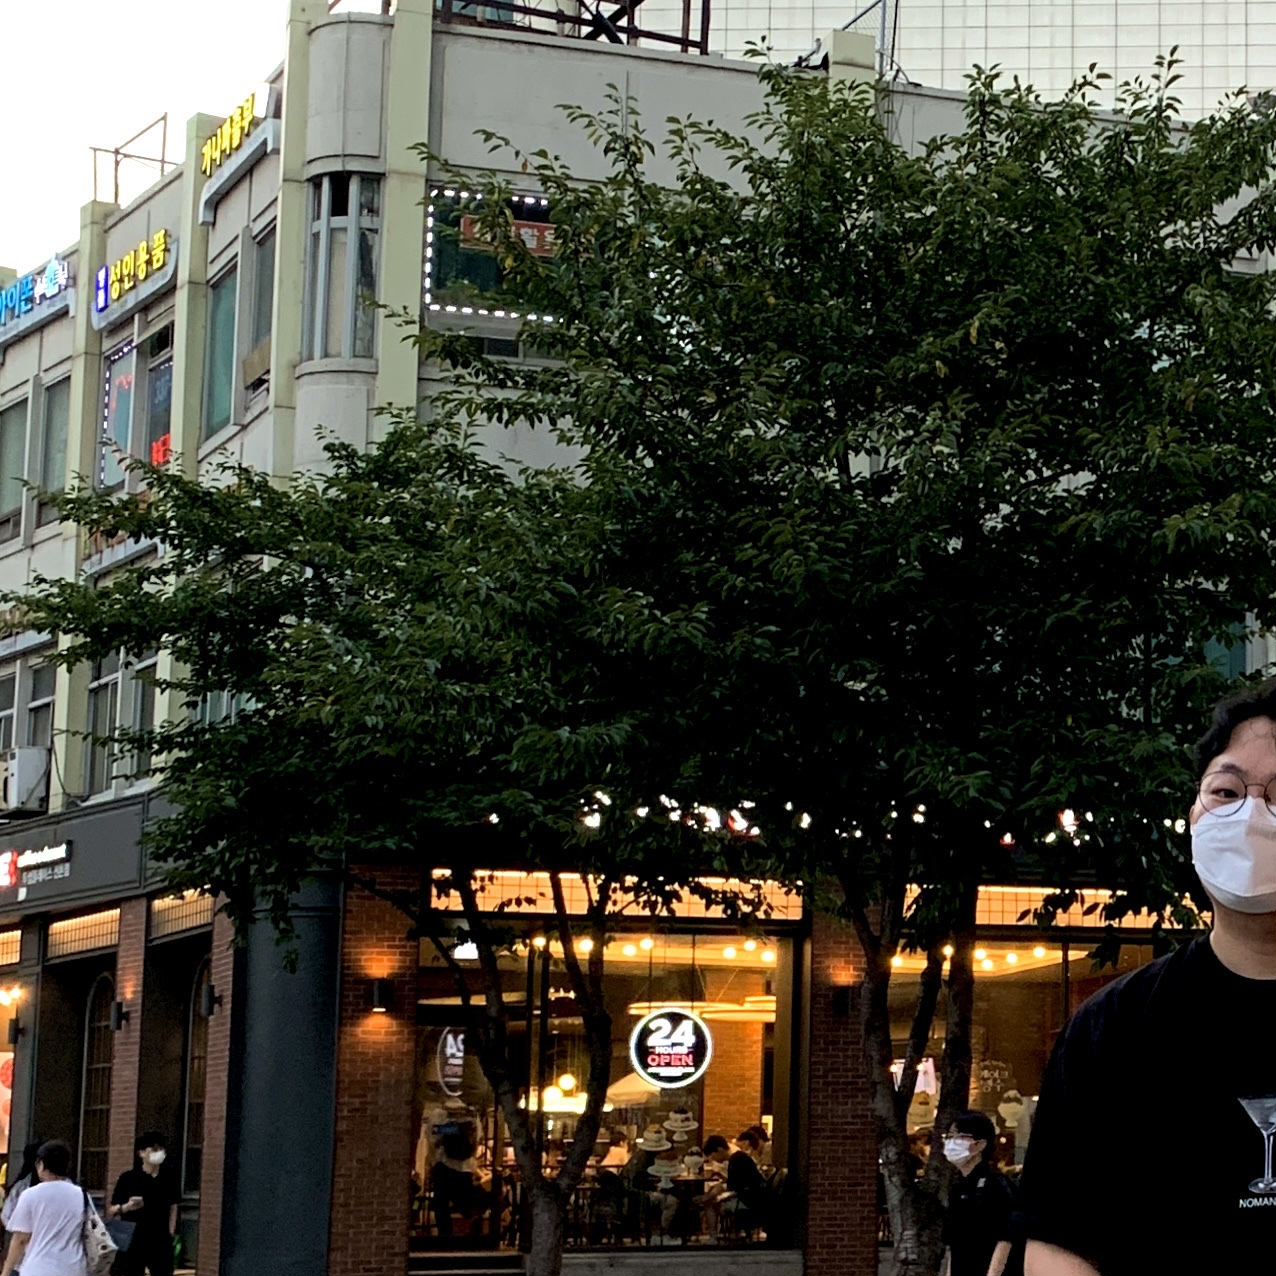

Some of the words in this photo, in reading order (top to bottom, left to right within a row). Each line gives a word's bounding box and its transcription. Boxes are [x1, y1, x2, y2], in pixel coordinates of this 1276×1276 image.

[109, 228, 167, 300] 성인용품
[647, 1018, 696, 1047] 24
[647, 1054, 694, 1066] OPEN
